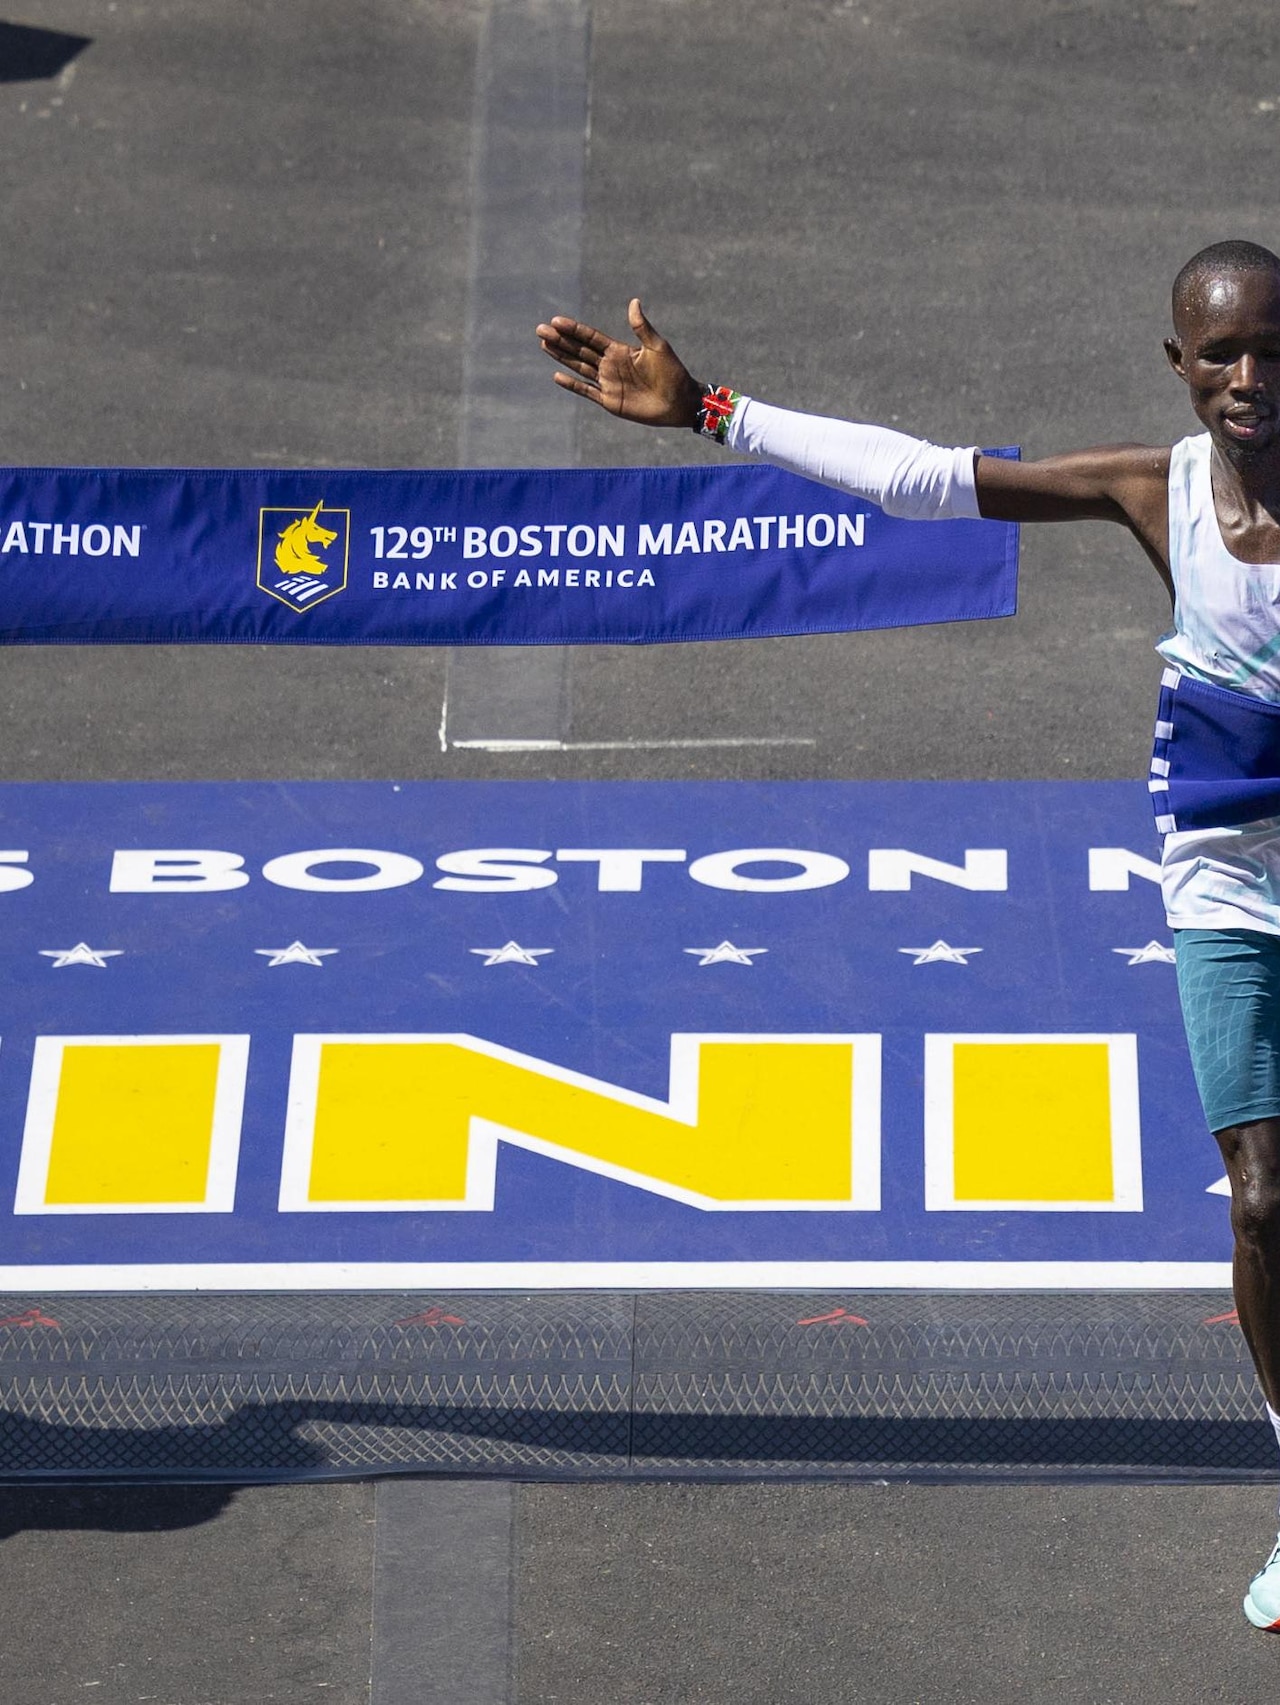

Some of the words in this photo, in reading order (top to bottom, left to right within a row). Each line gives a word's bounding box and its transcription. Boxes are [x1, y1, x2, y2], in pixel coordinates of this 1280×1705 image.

[0, 521, 141, 557] ATHON
[370, 526, 457, 560] 129TH
[462, 524, 625, 559] BOSTON
[637, 513, 865, 556] MARATHON
[373, 571, 458, 591] BANK
[466, 569, 507, 589] OF
[513, 568, 656, 588] AMERICA
[109, 848, 1008, 893] BOSTON
